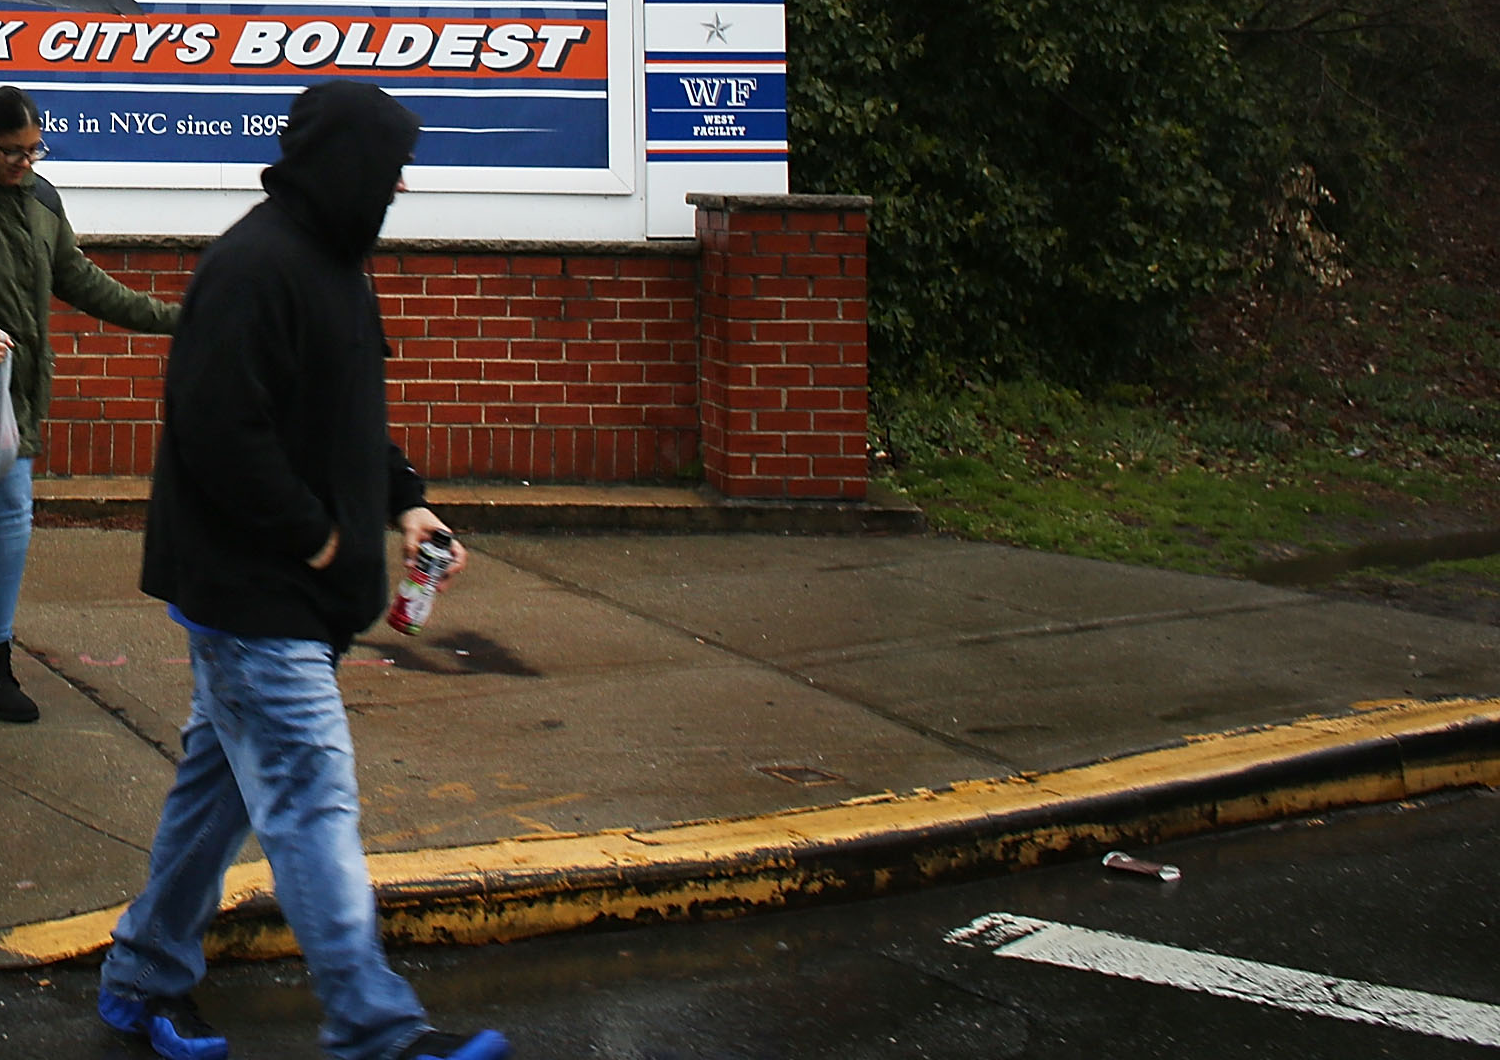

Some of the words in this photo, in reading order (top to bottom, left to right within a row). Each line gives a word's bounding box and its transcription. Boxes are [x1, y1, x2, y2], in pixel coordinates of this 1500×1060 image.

[38, 20, 219, 65] CITY'S
[230, 20, 591, 73] BOLDEST
[680, 77, 757, 108] WF
[78, 112, 100, 133] in
[110, 112, 167, 135] NYC
[176, 114, 232, 135] since
[693, 125, 746, 136] FACILITY
[703, 114, 734, 125] WEST
